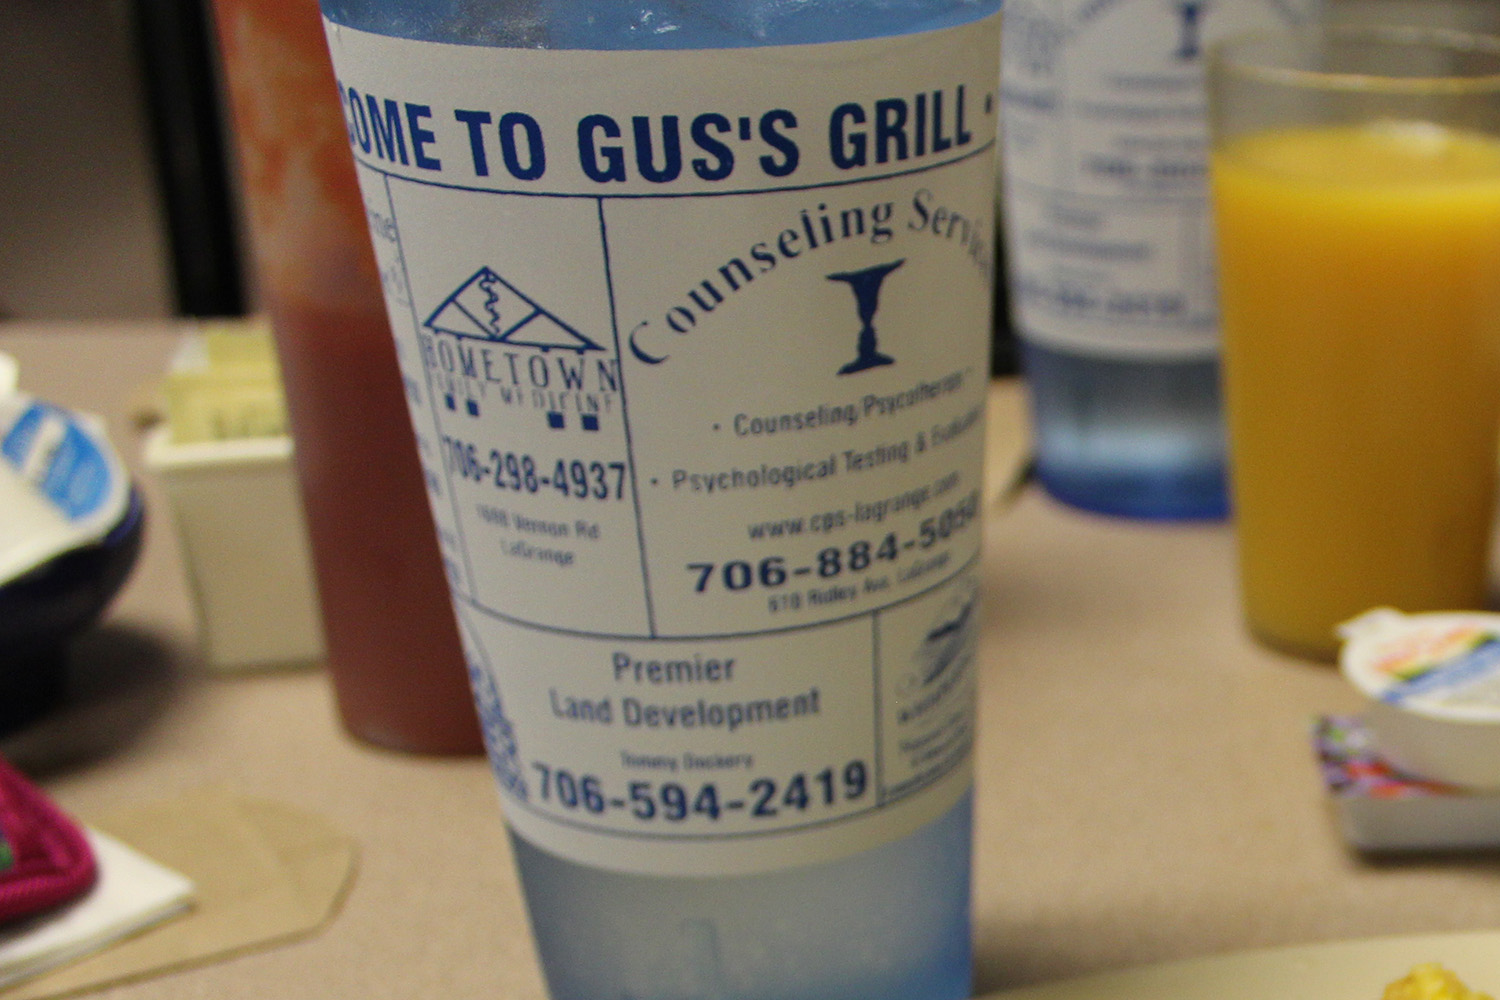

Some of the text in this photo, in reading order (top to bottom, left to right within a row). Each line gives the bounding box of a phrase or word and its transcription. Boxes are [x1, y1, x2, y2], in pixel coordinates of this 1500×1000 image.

[454, 109, 546, 181] TO
[577, 109, 799, 184] GUS'S
[829, 84, 970, 169] GRILL
[628, 202, 895, 365] Counseling
[421, 333, 619, 392] HOMETOWN
[733, 401, 858, 437] Counseling
[442, 435, 626, 501] 706-298-4937
[672, 453, 836, 494] Psychological
[612, 650, 736, 684] Premier
[549, 685, 821, 732] Land Development
[531, 759, 869, 821] 706-594-2419
